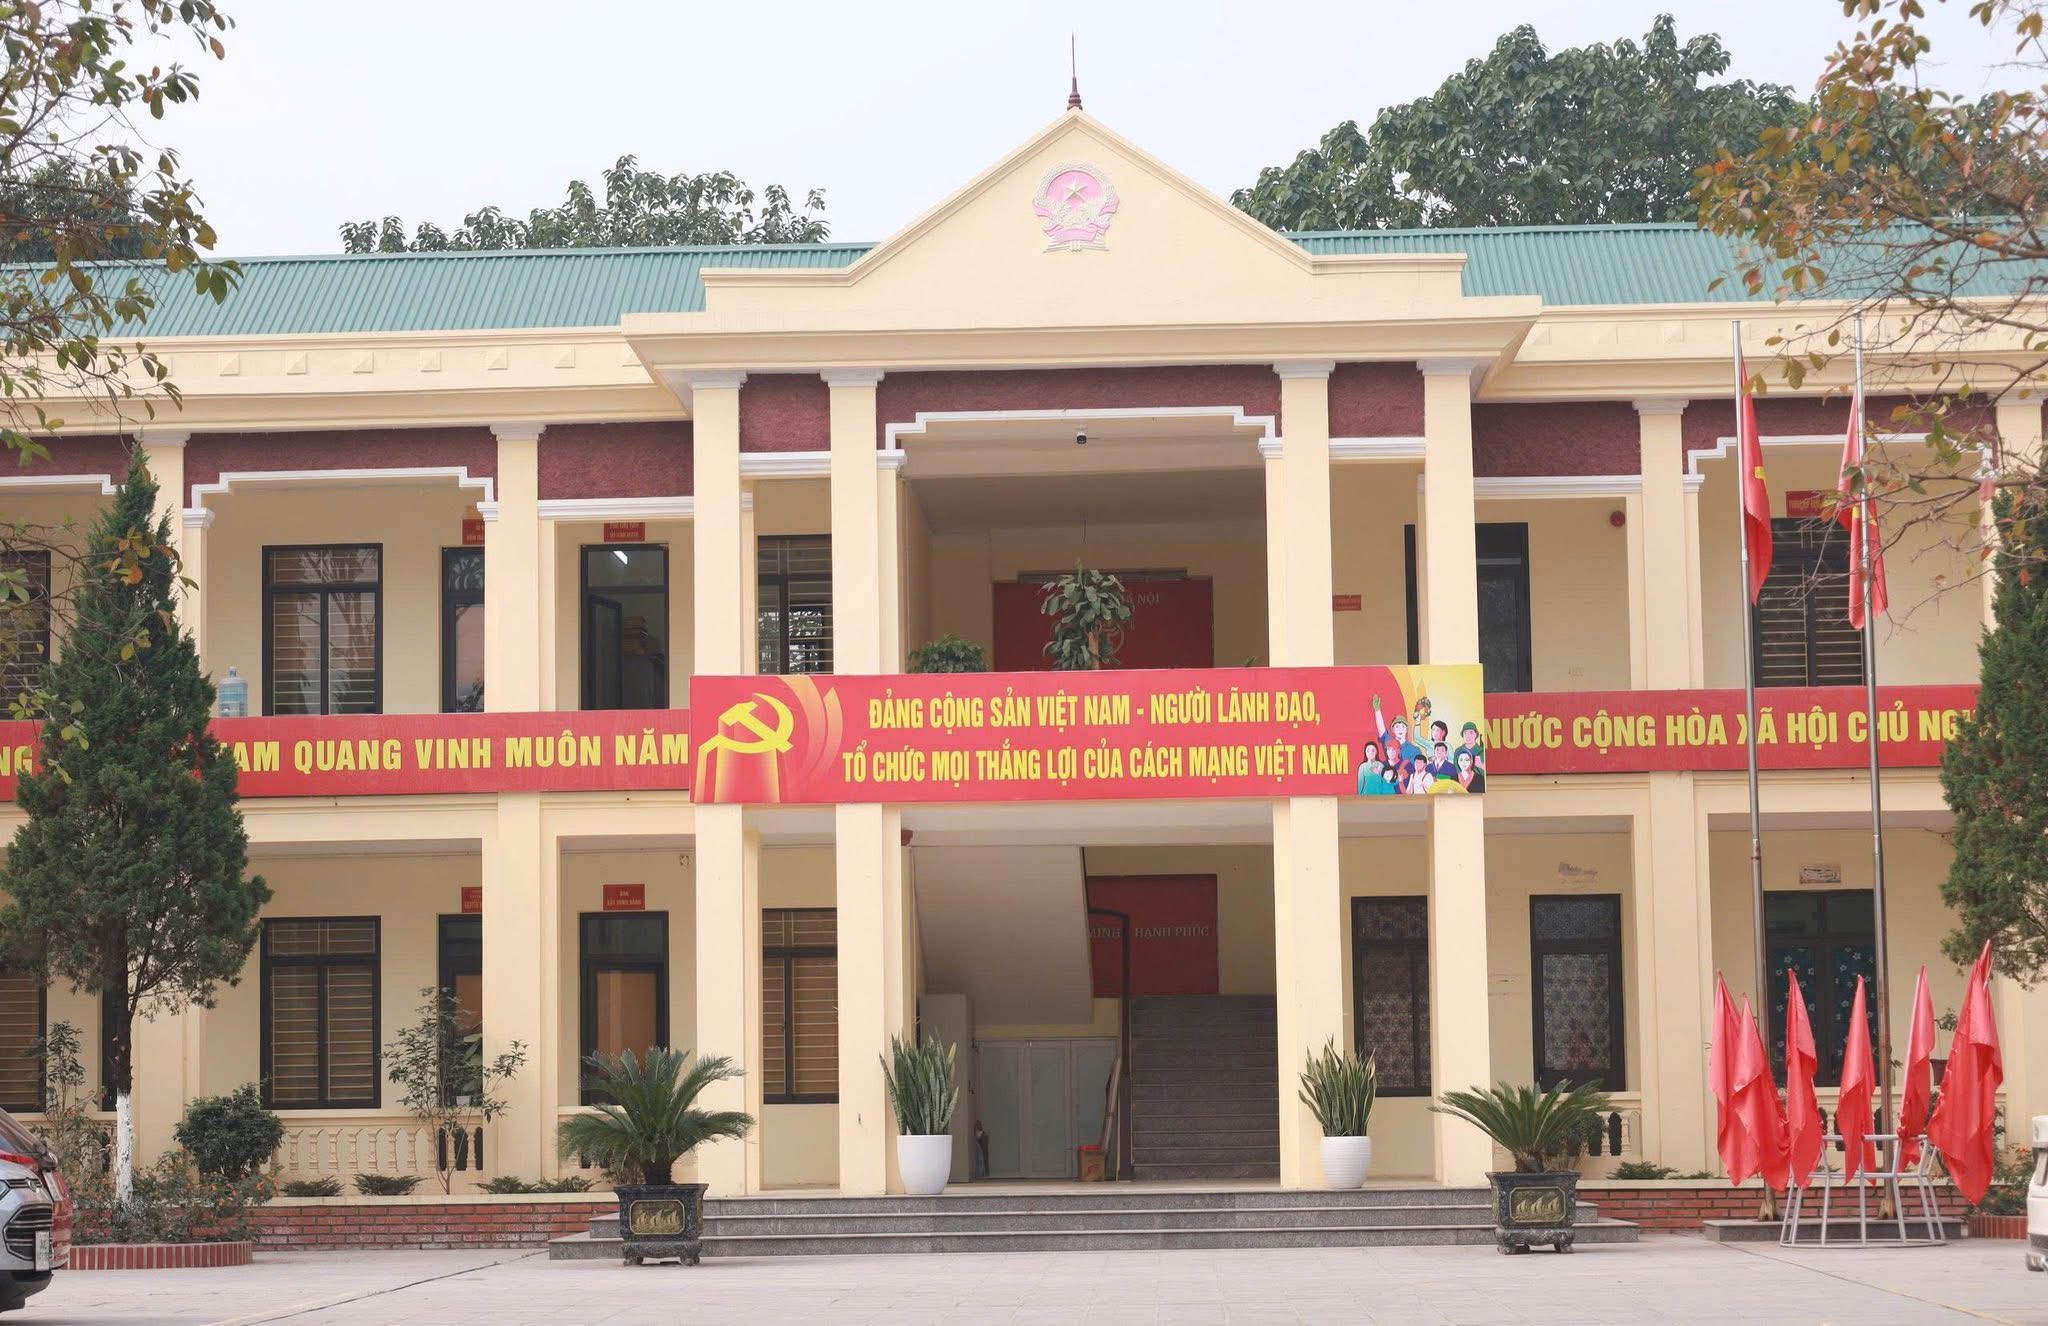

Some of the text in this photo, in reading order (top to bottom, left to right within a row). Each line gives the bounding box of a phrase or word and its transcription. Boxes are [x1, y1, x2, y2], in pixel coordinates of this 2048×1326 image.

[869, 685, 1321, 734] ĐẢNG CỘNG SẢN VIỆT NAM - NGƯỜI LÃNH ĐẠO,
[1484, 710, 1563, 749] NƯỚC
[1573, 709, 1656, 754] CỘNG
[1665, 706, 1728, 746] HÒA
[1787, 705, 1837, 751] HỘI
[1848, 700, 1909, 743] CHỦ
[216, 741, 280, 772] AM
[294, 739, 402, 775] QUANG
[415, 738, 491, 769] VINH
[505, 729, 601, 768] MUÔN
[615, 727, 689, 766] NĂM
[842, 738, 1349, 787] TỔ CHỨC MỌI THẮNG LỢI CỦA CÁCH MẠNG VIỆT NAM
